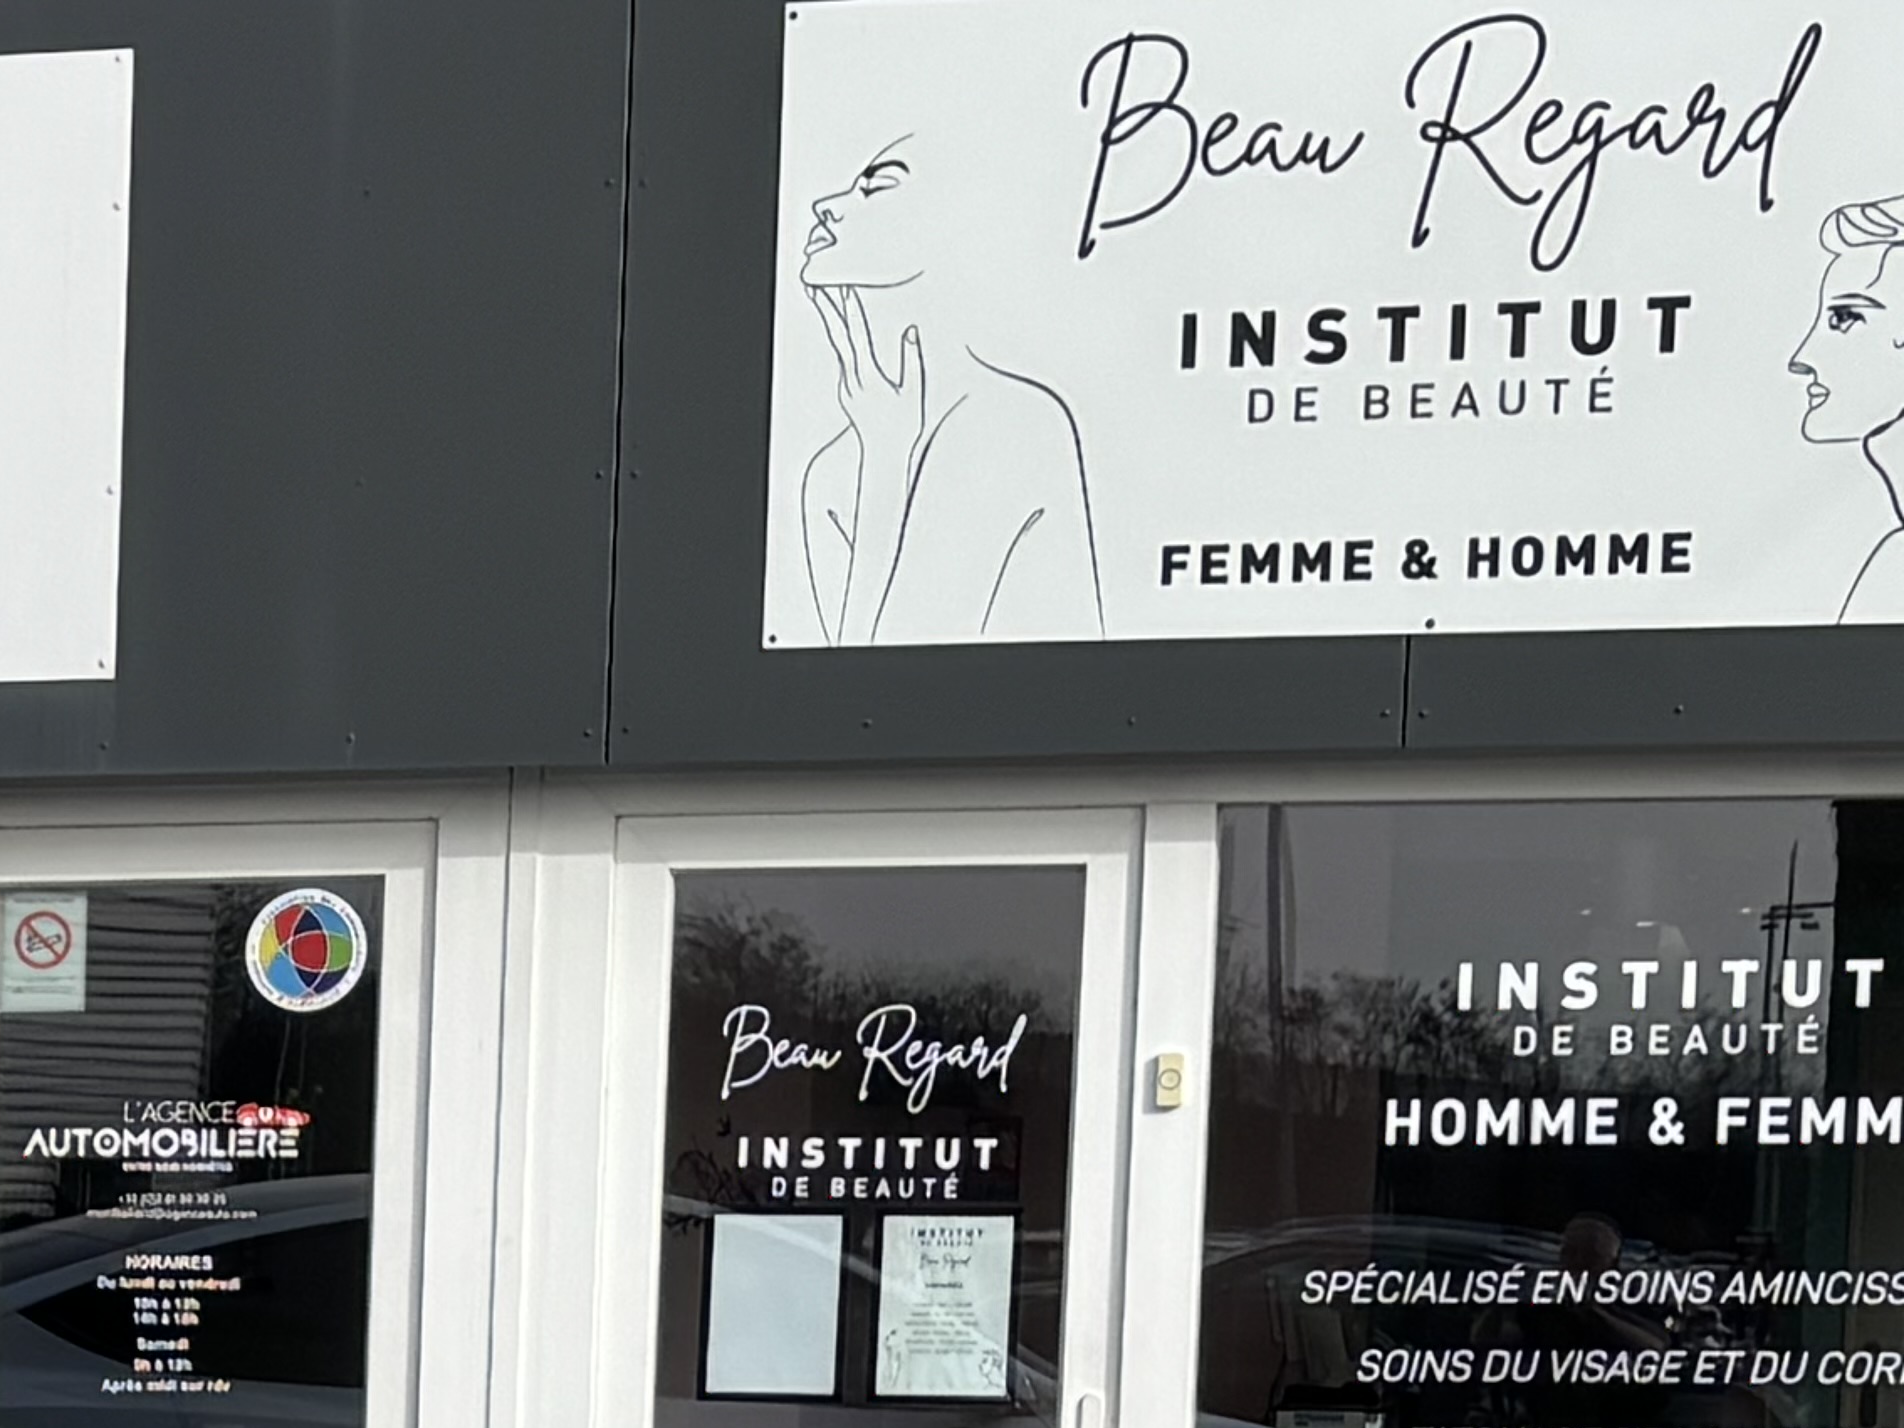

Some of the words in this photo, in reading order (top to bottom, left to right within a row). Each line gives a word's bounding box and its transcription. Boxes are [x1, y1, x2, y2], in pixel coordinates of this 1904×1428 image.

[1077, 32, 1365, 260] Beau
[1404, 13, 1823, 273] Regard
[1181, 295, 1692, 370] INSTITUT
[1247, 386, 1319, 424] DE
[1363, 365, 1614, 421] BEAUTÉ
[1160, 539, 1374, 586] FEMME
[1401, 538, 1438, 580] &
[1467, 531, 1693, 579] HOMME
[1457, 958, 1884, 1011] INSTITUT
[721, 1004, 841, 1099] Beau
[857, 1003, 1027, 1113] Regard
[1513, 1024, 1574, 1056] DE
[1605, 1013, 1827, 1060] BEAUTÉ
[123, 1101, 235, 1123] L'AGENCE
[1384, 1097, 1619, 1146] HOMME
[1648, 1097, 1685, 1146] &
[1716, 1096, 1903, 1145] FEMM
[737, 1136, 998, 1170] INSTITUT
[771, 1175, 809, 1198] DE
[830, 1172, 959, 1199] BEAUTÉ
[1302, 1262, 1523, 1306] SPÉCIALISÉ
[1532, 1270, 1587, 1305] EN
[1594, 1270, 1715, 1306] SOINS
[1356, 1350, 1474, 1383] SOINS
[1482, 1350, 1540, 1383] DU
[1553, 1350, 1685, 1385] VISAGE
[1693, 1350, 1742, 1383] ET
[1750, 1350, 1811, 1383] DU
[1817, 1350, 1904, 1386] COR
